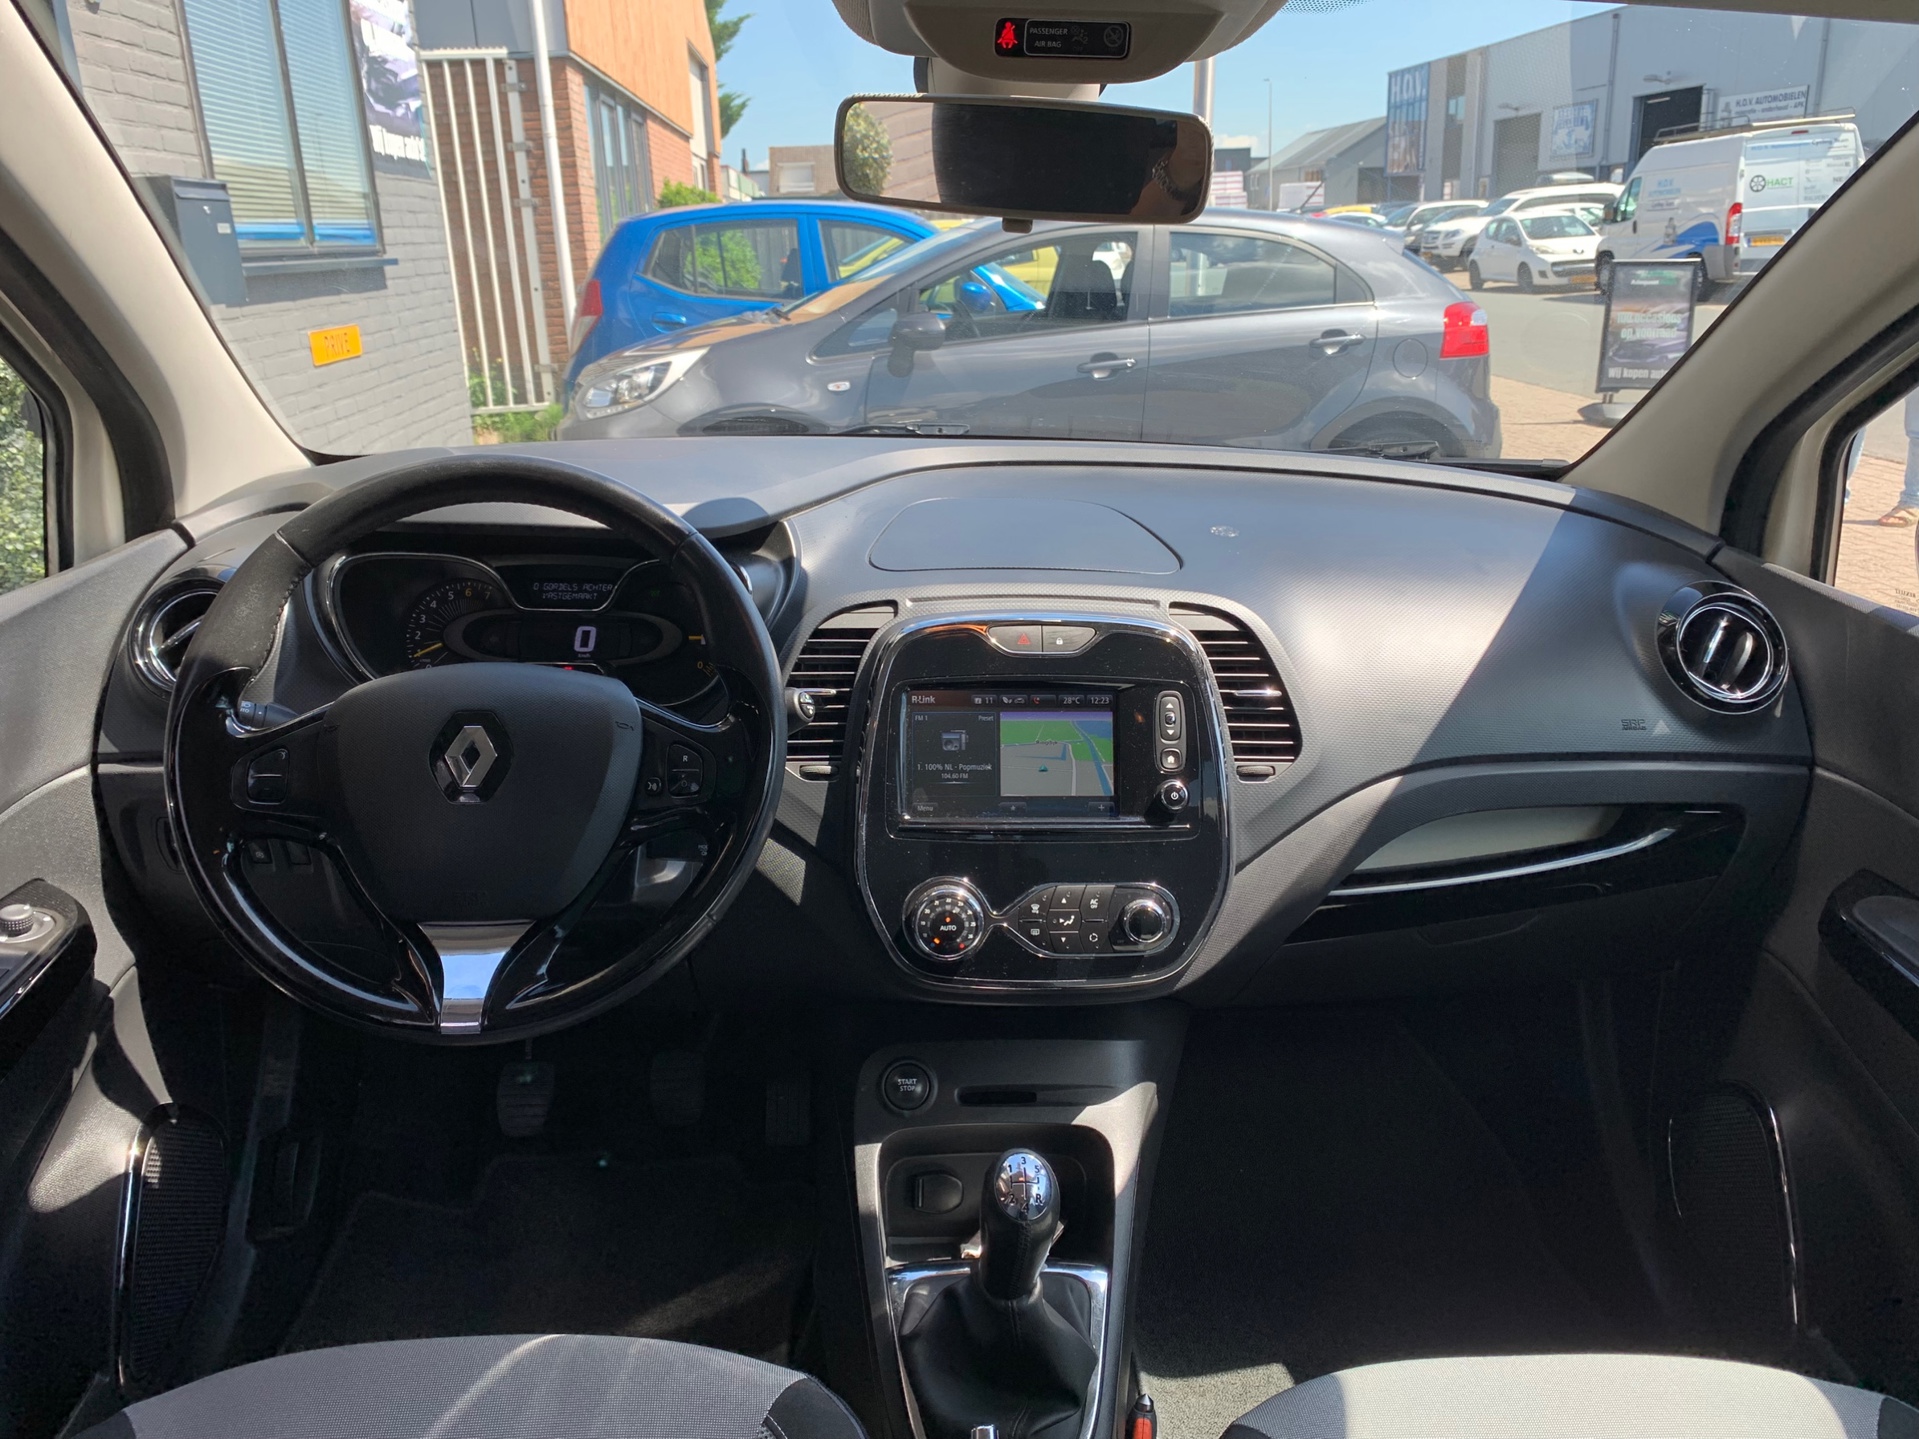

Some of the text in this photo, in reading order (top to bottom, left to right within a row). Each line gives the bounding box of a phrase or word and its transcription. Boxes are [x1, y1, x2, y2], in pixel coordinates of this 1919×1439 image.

[1030, 27, 1068, 35] PASSENGER
[1755, 90, 1806, 104] AUTOMOBIELEN
[1766, 176, 1794, 186] HACT
[1623, 368, 1648, 380] kopen
[583, 584, 613, 592] ACHTER
[574, 626, 597, 652] 0
[1063, 696, 1080, 705] 28°C
[1090, 696, 1110, 705] 12:23
[959, 764, 992, 772] Popmuziek
[1021, 1156, 1027, 1165] 3
[1034, 1165, 1040, 1174] 5
[1009, 1194, 1015, 1203] 2
[1036, 1194, 1042, 1203] R
